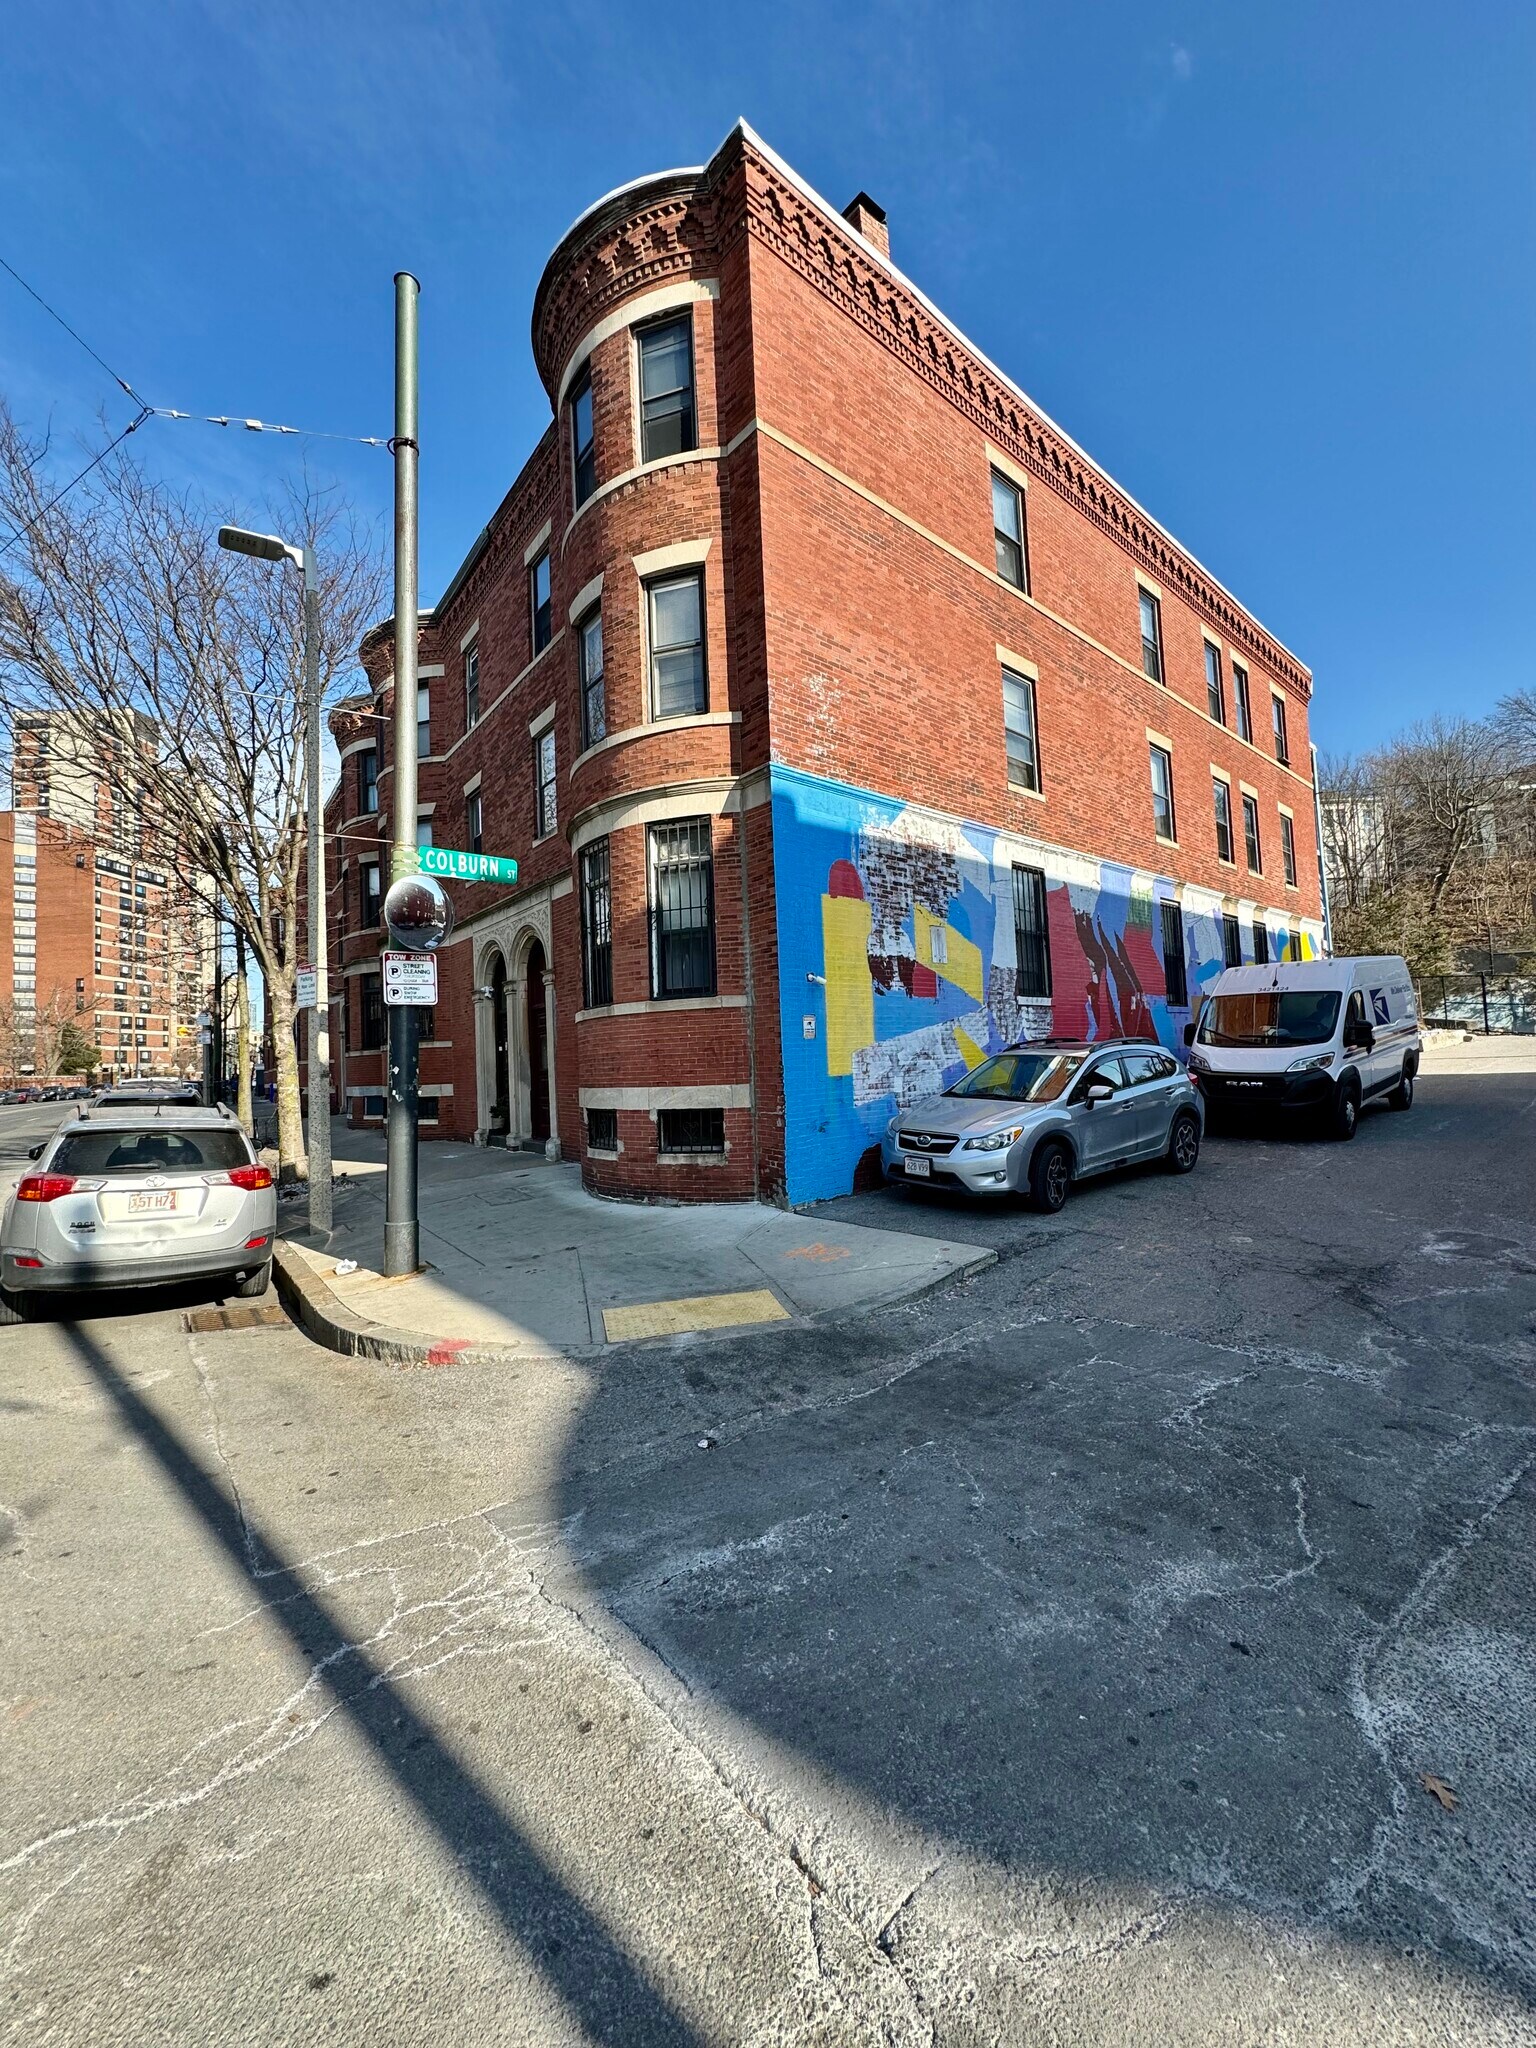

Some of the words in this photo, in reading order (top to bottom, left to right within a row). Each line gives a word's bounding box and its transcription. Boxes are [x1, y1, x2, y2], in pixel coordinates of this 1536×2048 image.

[425, 849, 499, 877] COLBURN
[506, 869, 516, 879] ST
[387, 953, 407, 961] TOW
